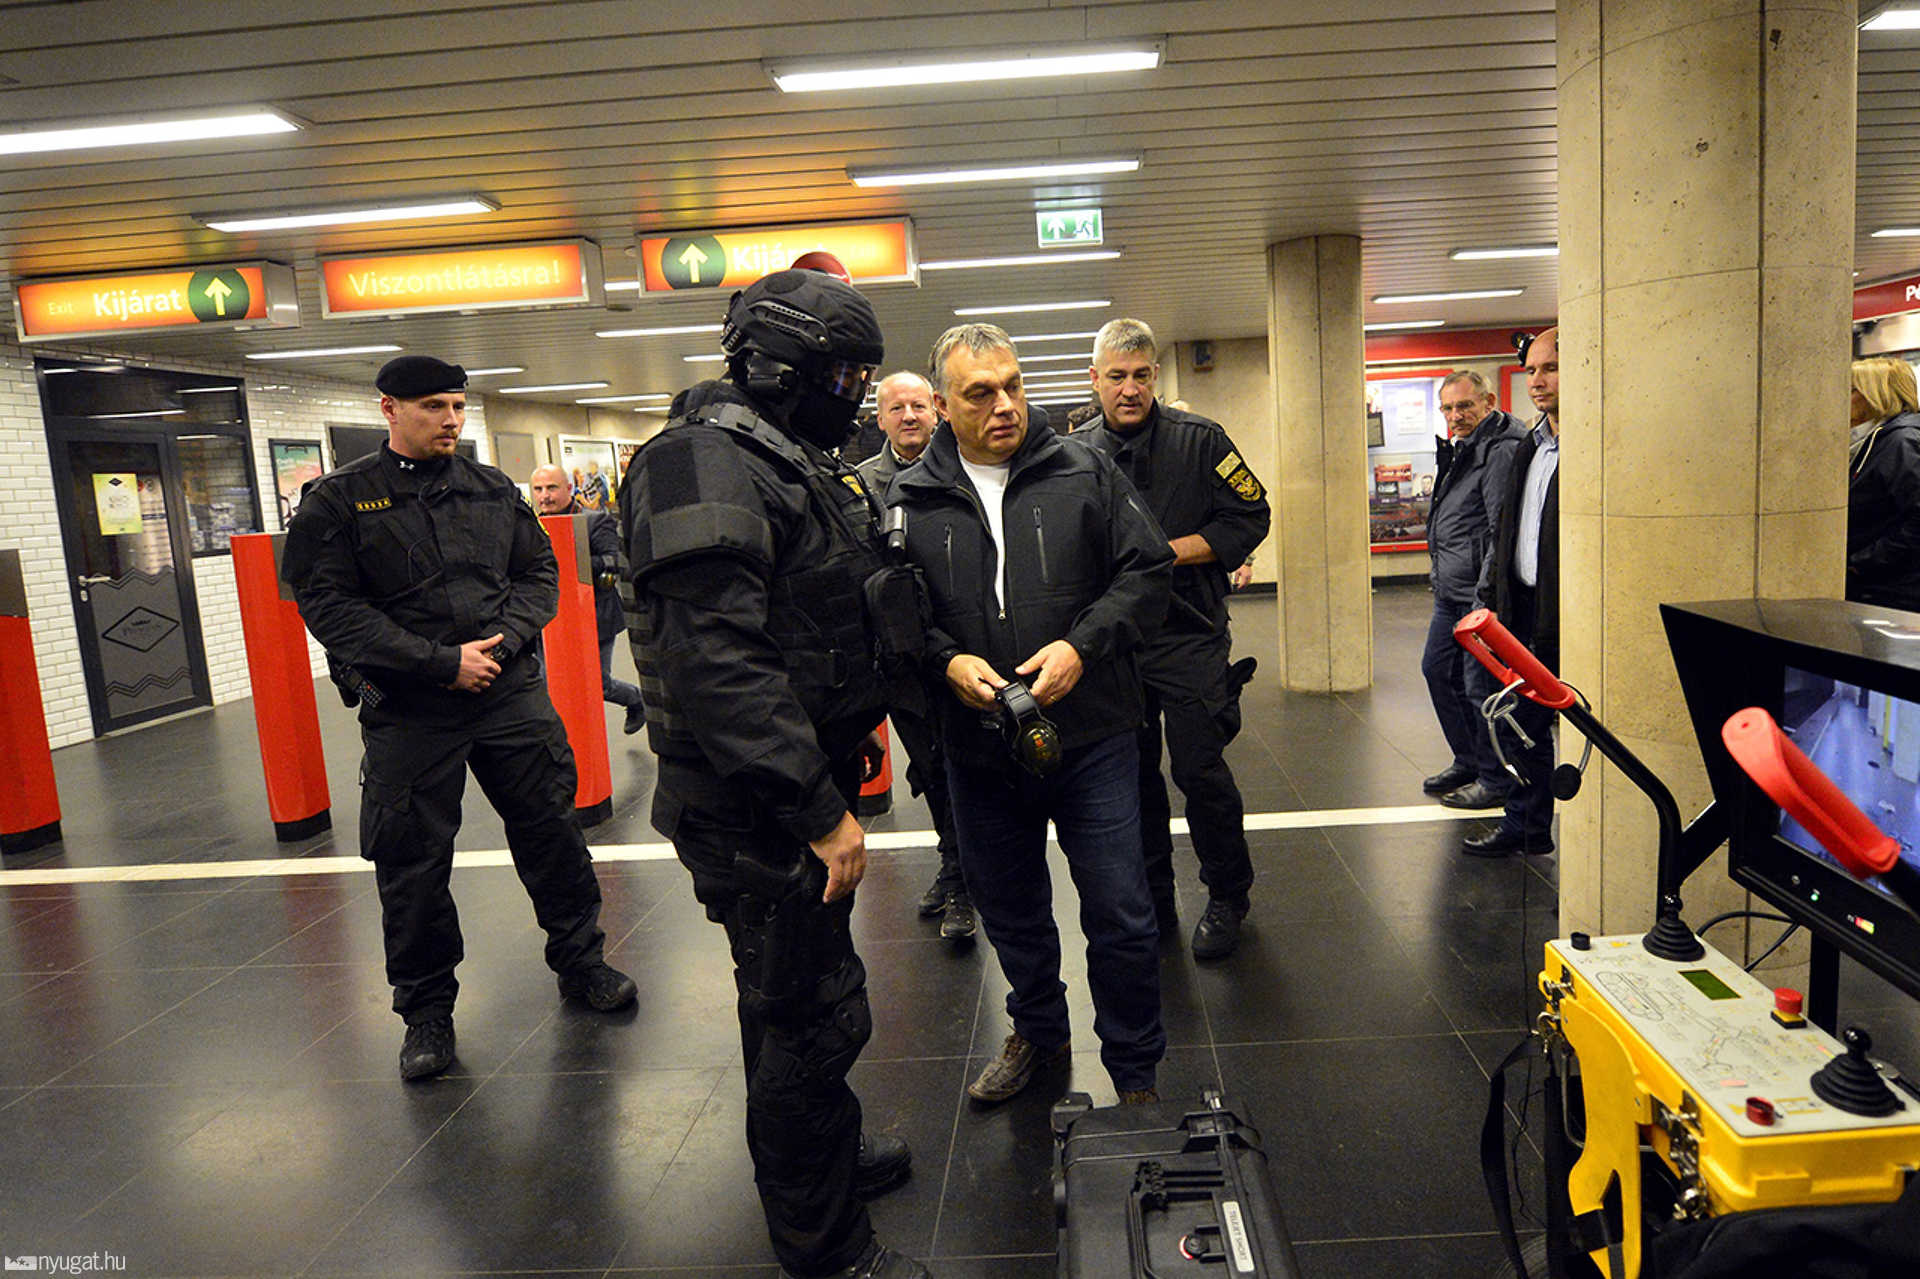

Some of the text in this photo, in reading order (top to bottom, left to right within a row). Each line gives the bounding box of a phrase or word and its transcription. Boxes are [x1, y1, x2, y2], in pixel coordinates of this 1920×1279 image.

[732, 242, 827, 276] Kijár
[348, 260, 561, 297] Viszontlátásra!
[47, 287, 183, 322] Exit Kijárat
